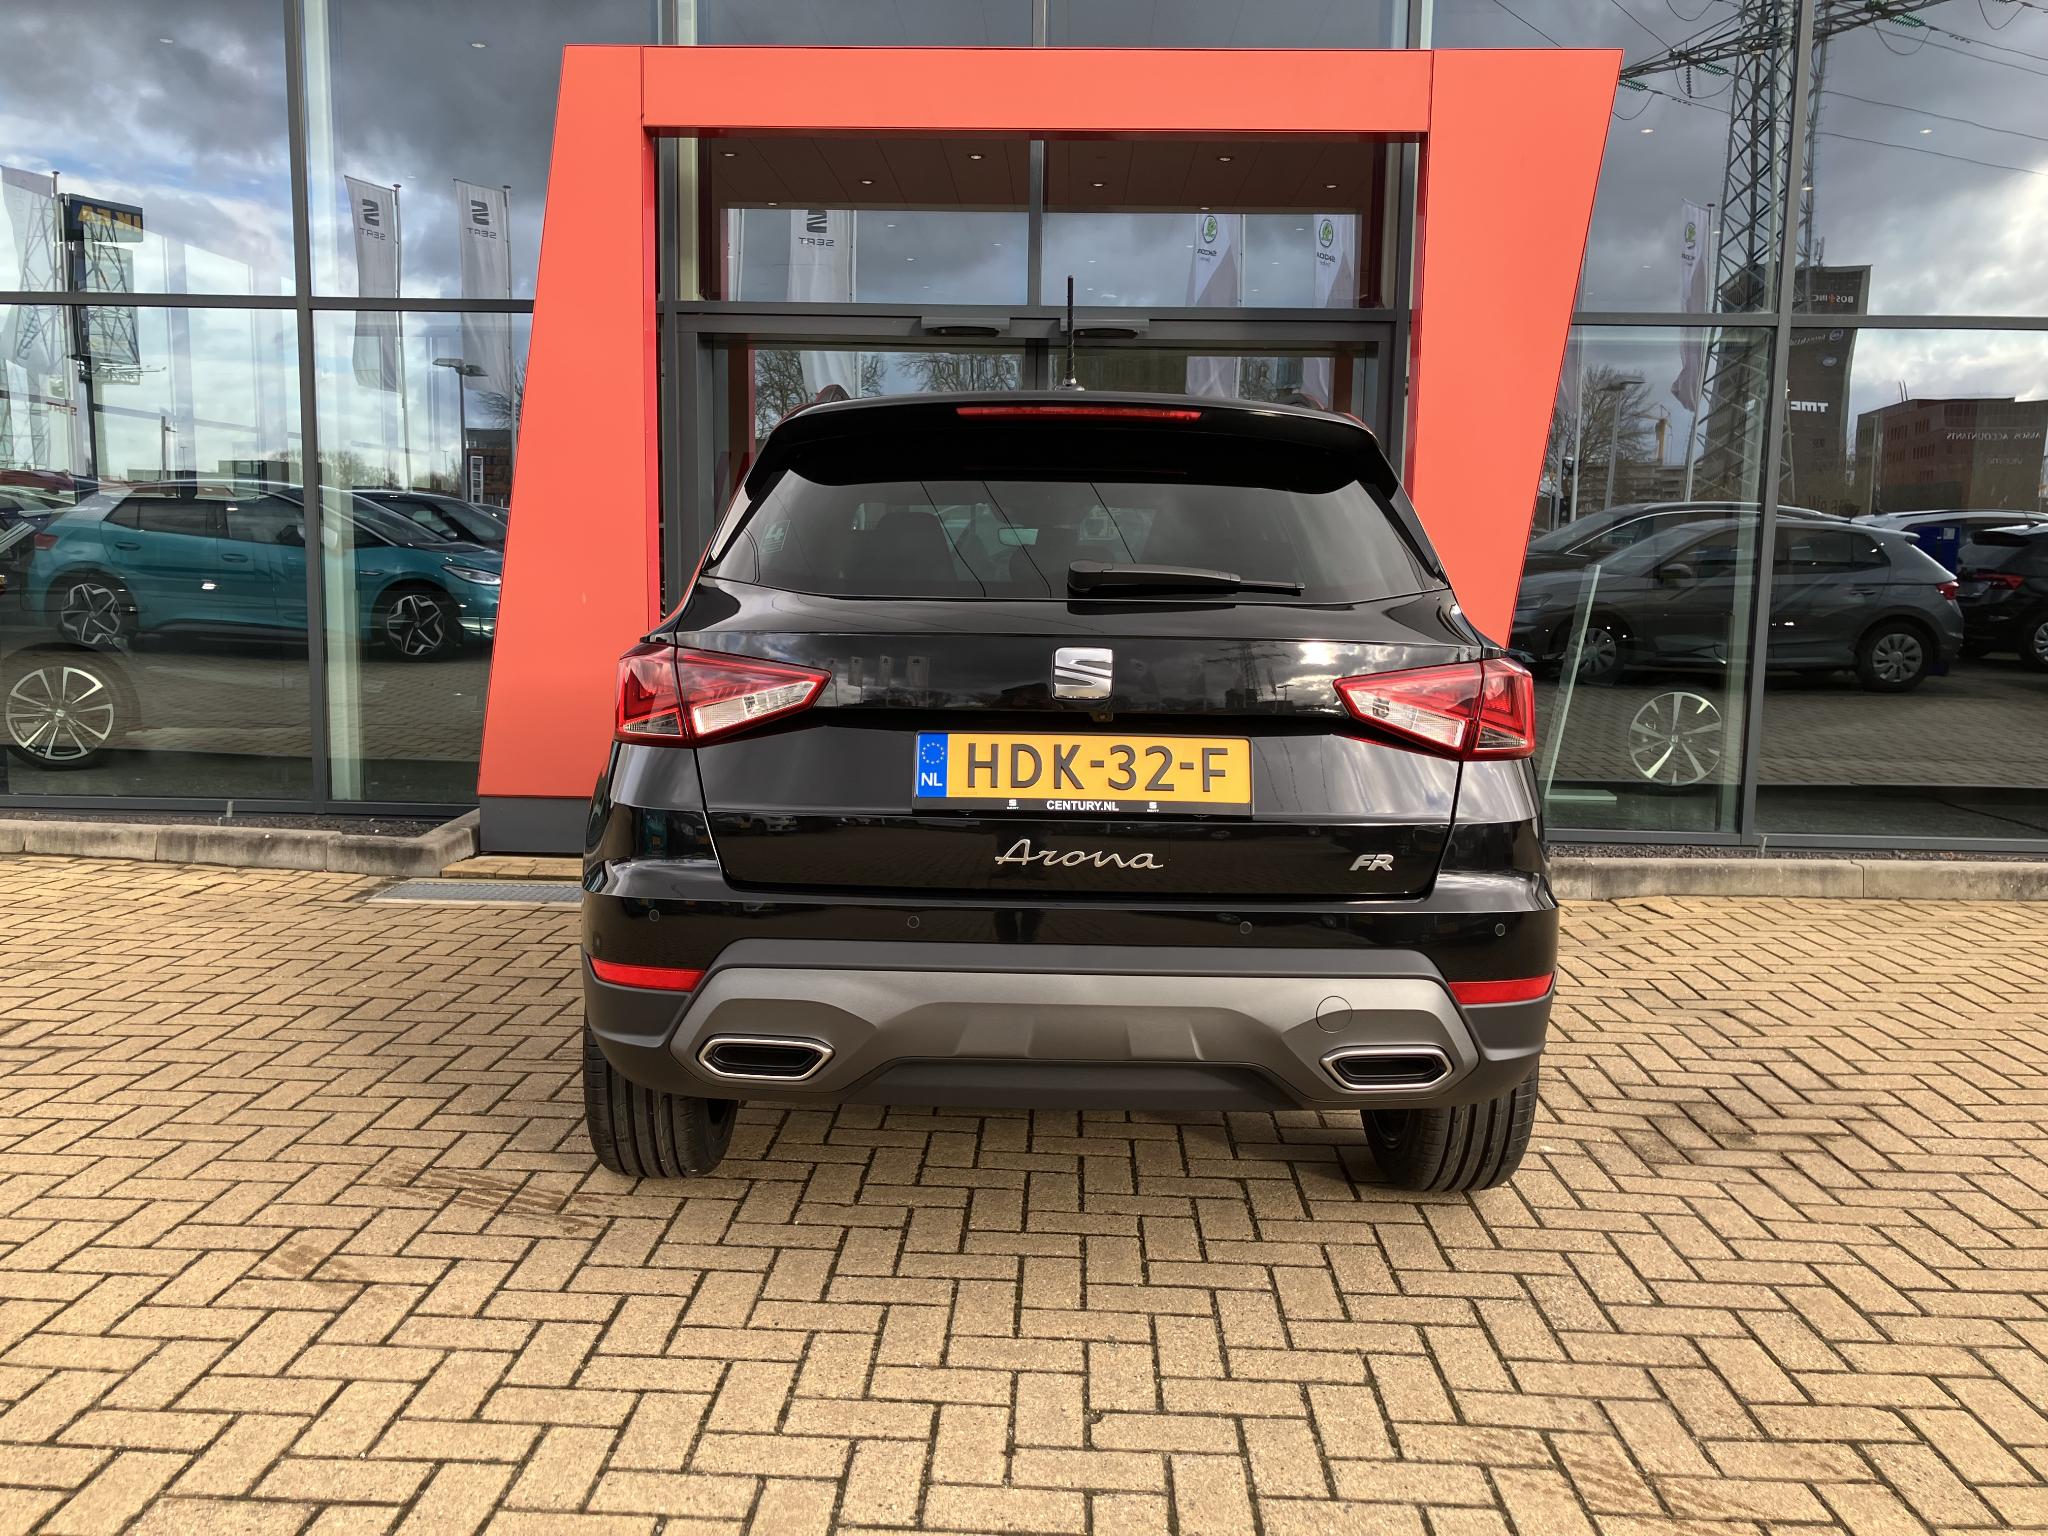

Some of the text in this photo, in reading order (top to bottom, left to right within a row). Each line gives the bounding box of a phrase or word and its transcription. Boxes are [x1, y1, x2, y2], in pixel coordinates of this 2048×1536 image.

[966, 742, 1229, 793] HDK-32-F
[920, 772, 943, 787] NL
[1046, 800, 1120, 812] CENTURY.NL
[995, 838, 1164, 870] Arona
[1349, 853, 1394, 871] FR
